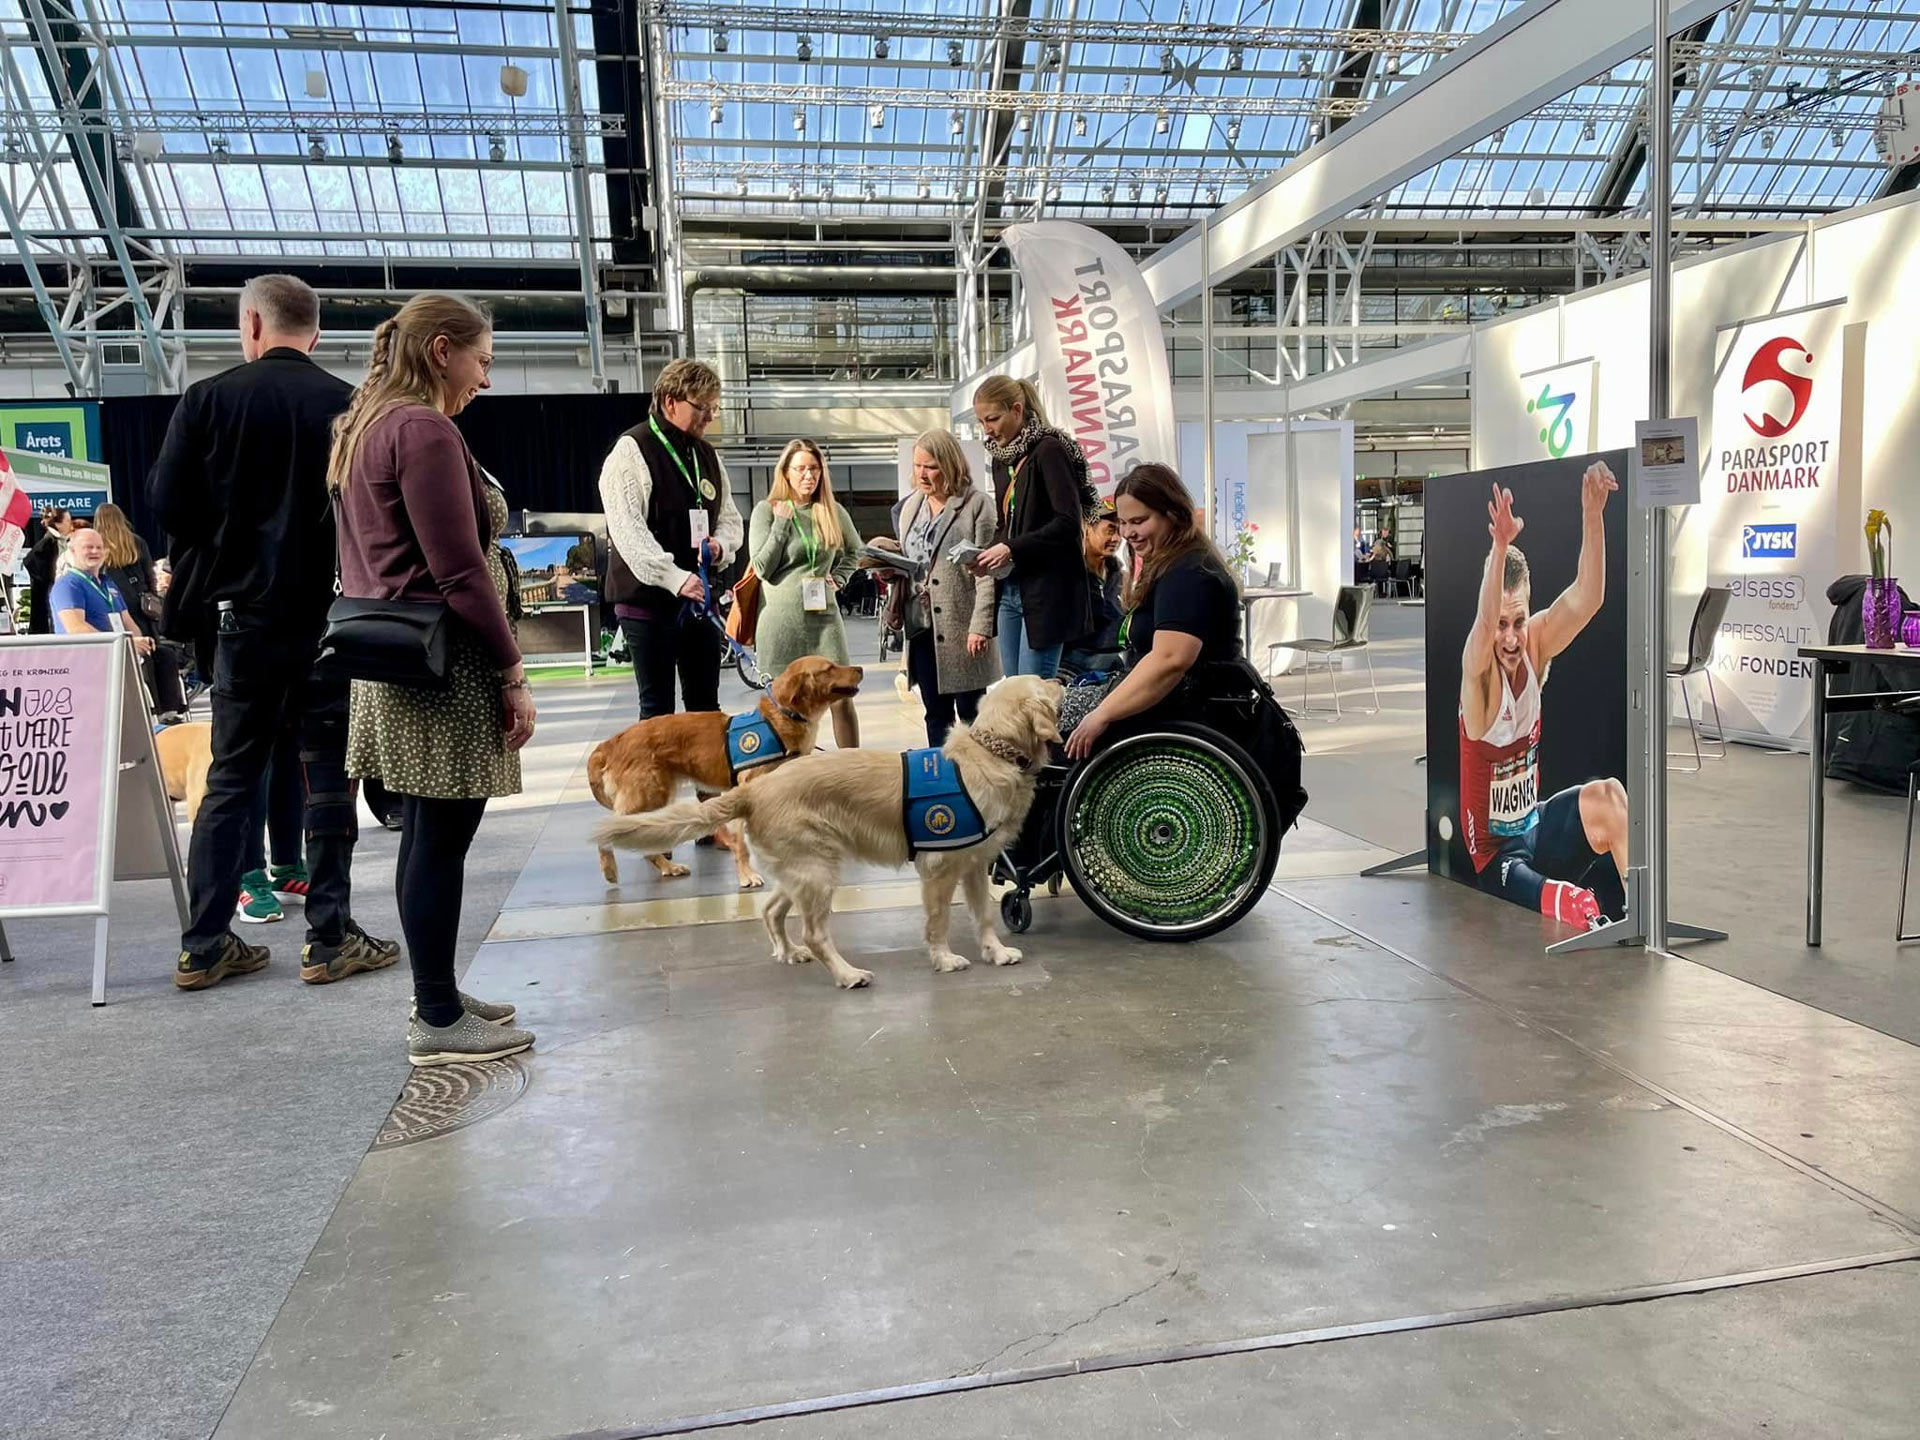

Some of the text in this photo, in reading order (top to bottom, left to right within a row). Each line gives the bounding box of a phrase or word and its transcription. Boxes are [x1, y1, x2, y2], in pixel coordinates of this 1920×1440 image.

[26, 431, 62, 448] Årets
[1721, 440, 1829, 471] PARASPORT
[1727, 465, 1820, 493] DANMARK
[30, 497, 92, 509] ISH.CARE
[1752, 531, 1794, 550] JYSK
[1732, 574, 1795, 598] elsass
[1769, 600, 1795, 610] fonden
[1492, 774, 1536, 814] WAGNER
